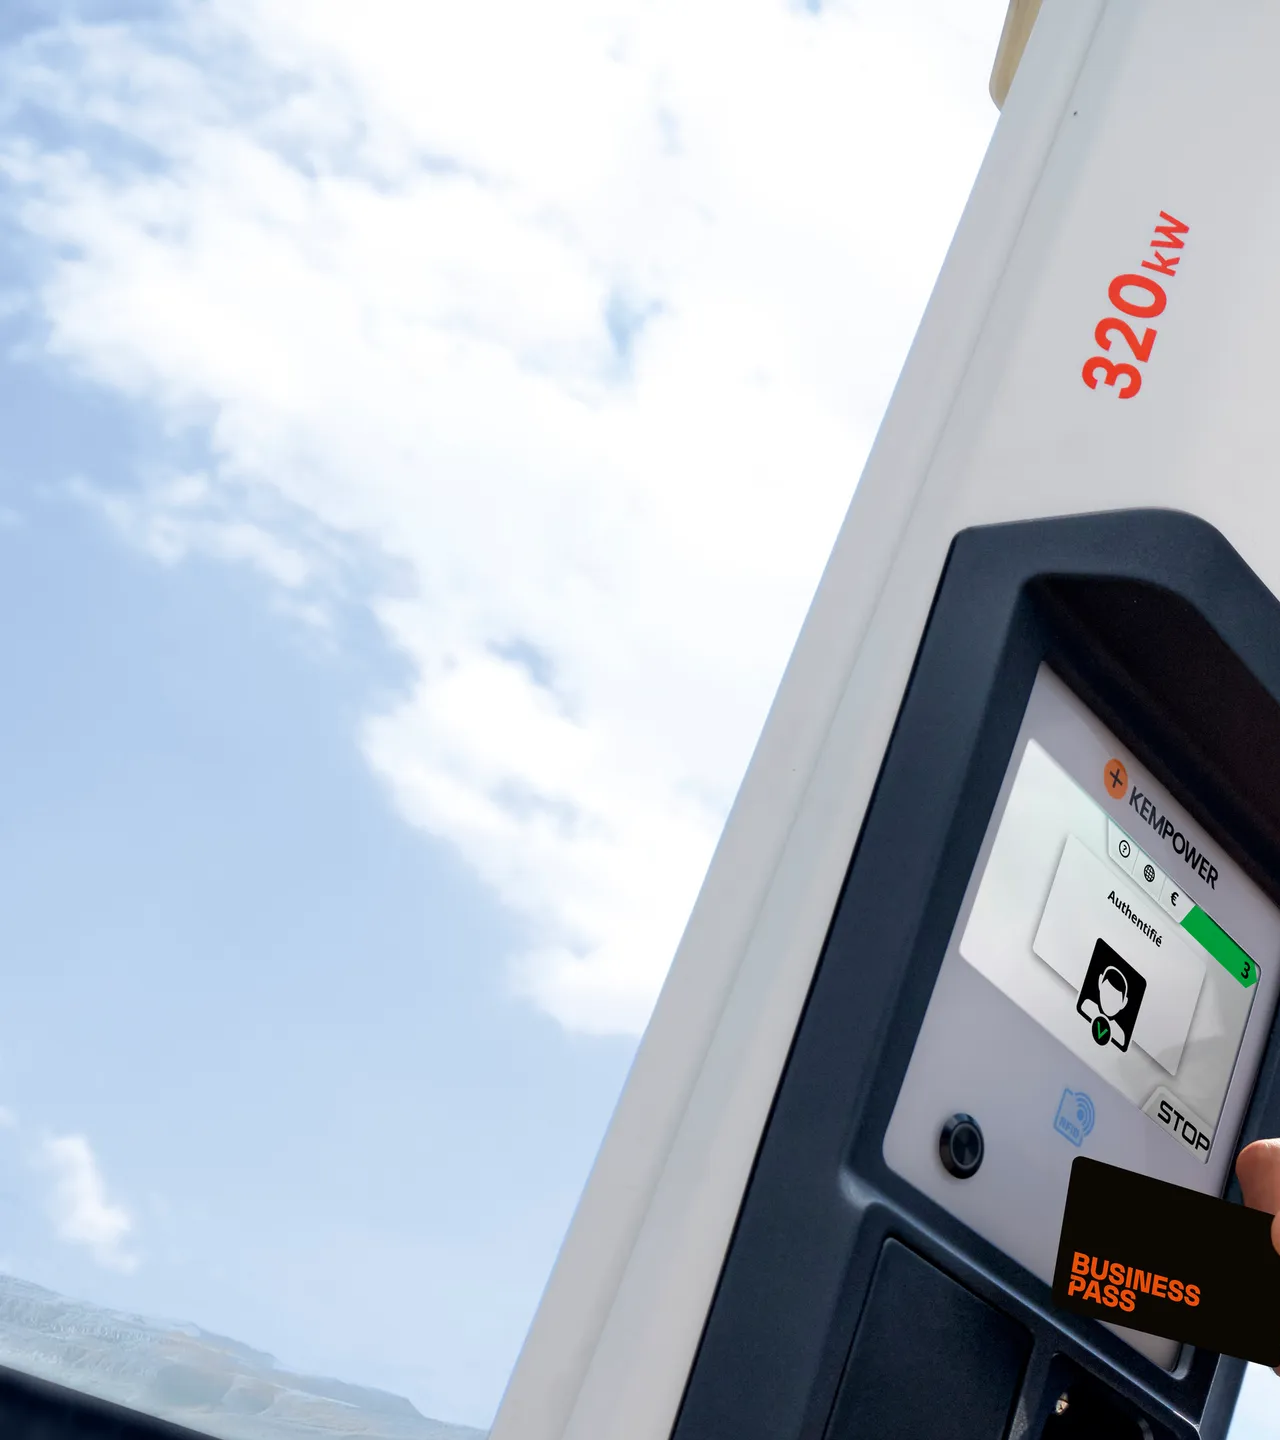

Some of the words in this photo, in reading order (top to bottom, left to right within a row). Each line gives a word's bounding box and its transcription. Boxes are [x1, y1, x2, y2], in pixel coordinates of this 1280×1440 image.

[1129, 786, 1219, 890] KEMPOWER
[1107, 890, 1163, 948] Authentifié
[1240, 961, 1251, 980] 3
[1157, 1100, 1211, 1151] STOP
[1067, 1274, 1137, 1312] PASS
[1071, 1251, 1201, 1307] BUSINESS
